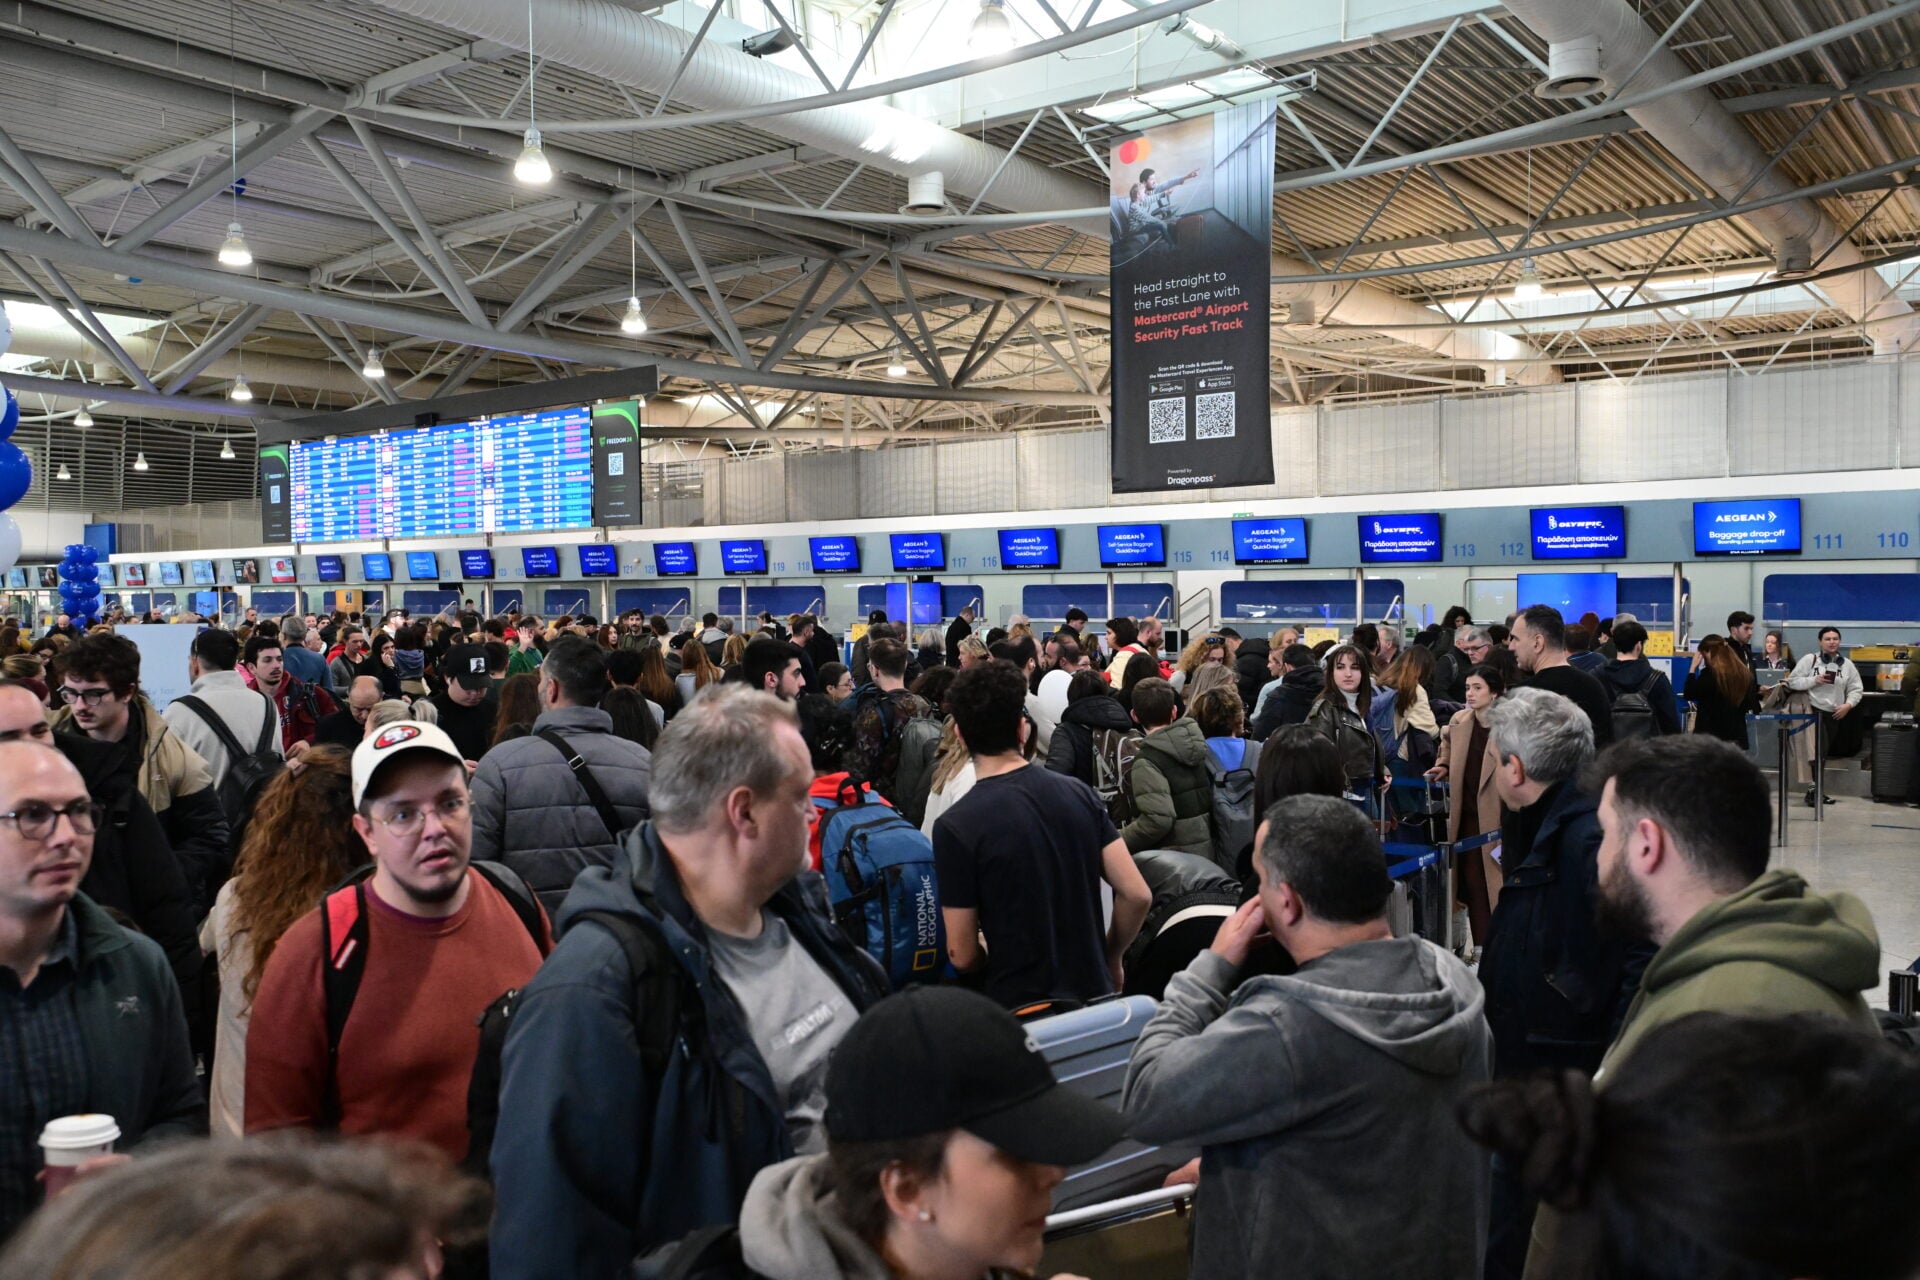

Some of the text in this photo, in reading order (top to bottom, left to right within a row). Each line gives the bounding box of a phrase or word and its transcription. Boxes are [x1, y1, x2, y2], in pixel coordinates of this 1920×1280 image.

[1134, 272, 1226, 294] Head straight to
[1134, 285, 1240, 310] the Fast Lane with
[1205, 301, 1248, 316] Airport
[1135, 318, 1242, 342] Security Fast Track
[1168, 476, 1213, 485] Dragonpass
[1715, 513, 1765, 522] AEGEAN
[1709, 530, 1785, 540] Baggage drop-off
[1877, 532, 1909, 548] 110
[1814, 534, 1842, 549] 111
[1453, 544, 1475, 556] 113
[1500, 543, 1524, 556] 112
[982, 556, 997, 568] 116
[1174, 551, 1192, 562] 115
[1211, 550, 1229, 562] 114
[798, 561, 809, 571] 118
[952, 557, 966, 568] 117
[921, 875, 936, 945] GEOGRAPHIC
[916, 889, 927, 946] NATIONAL
